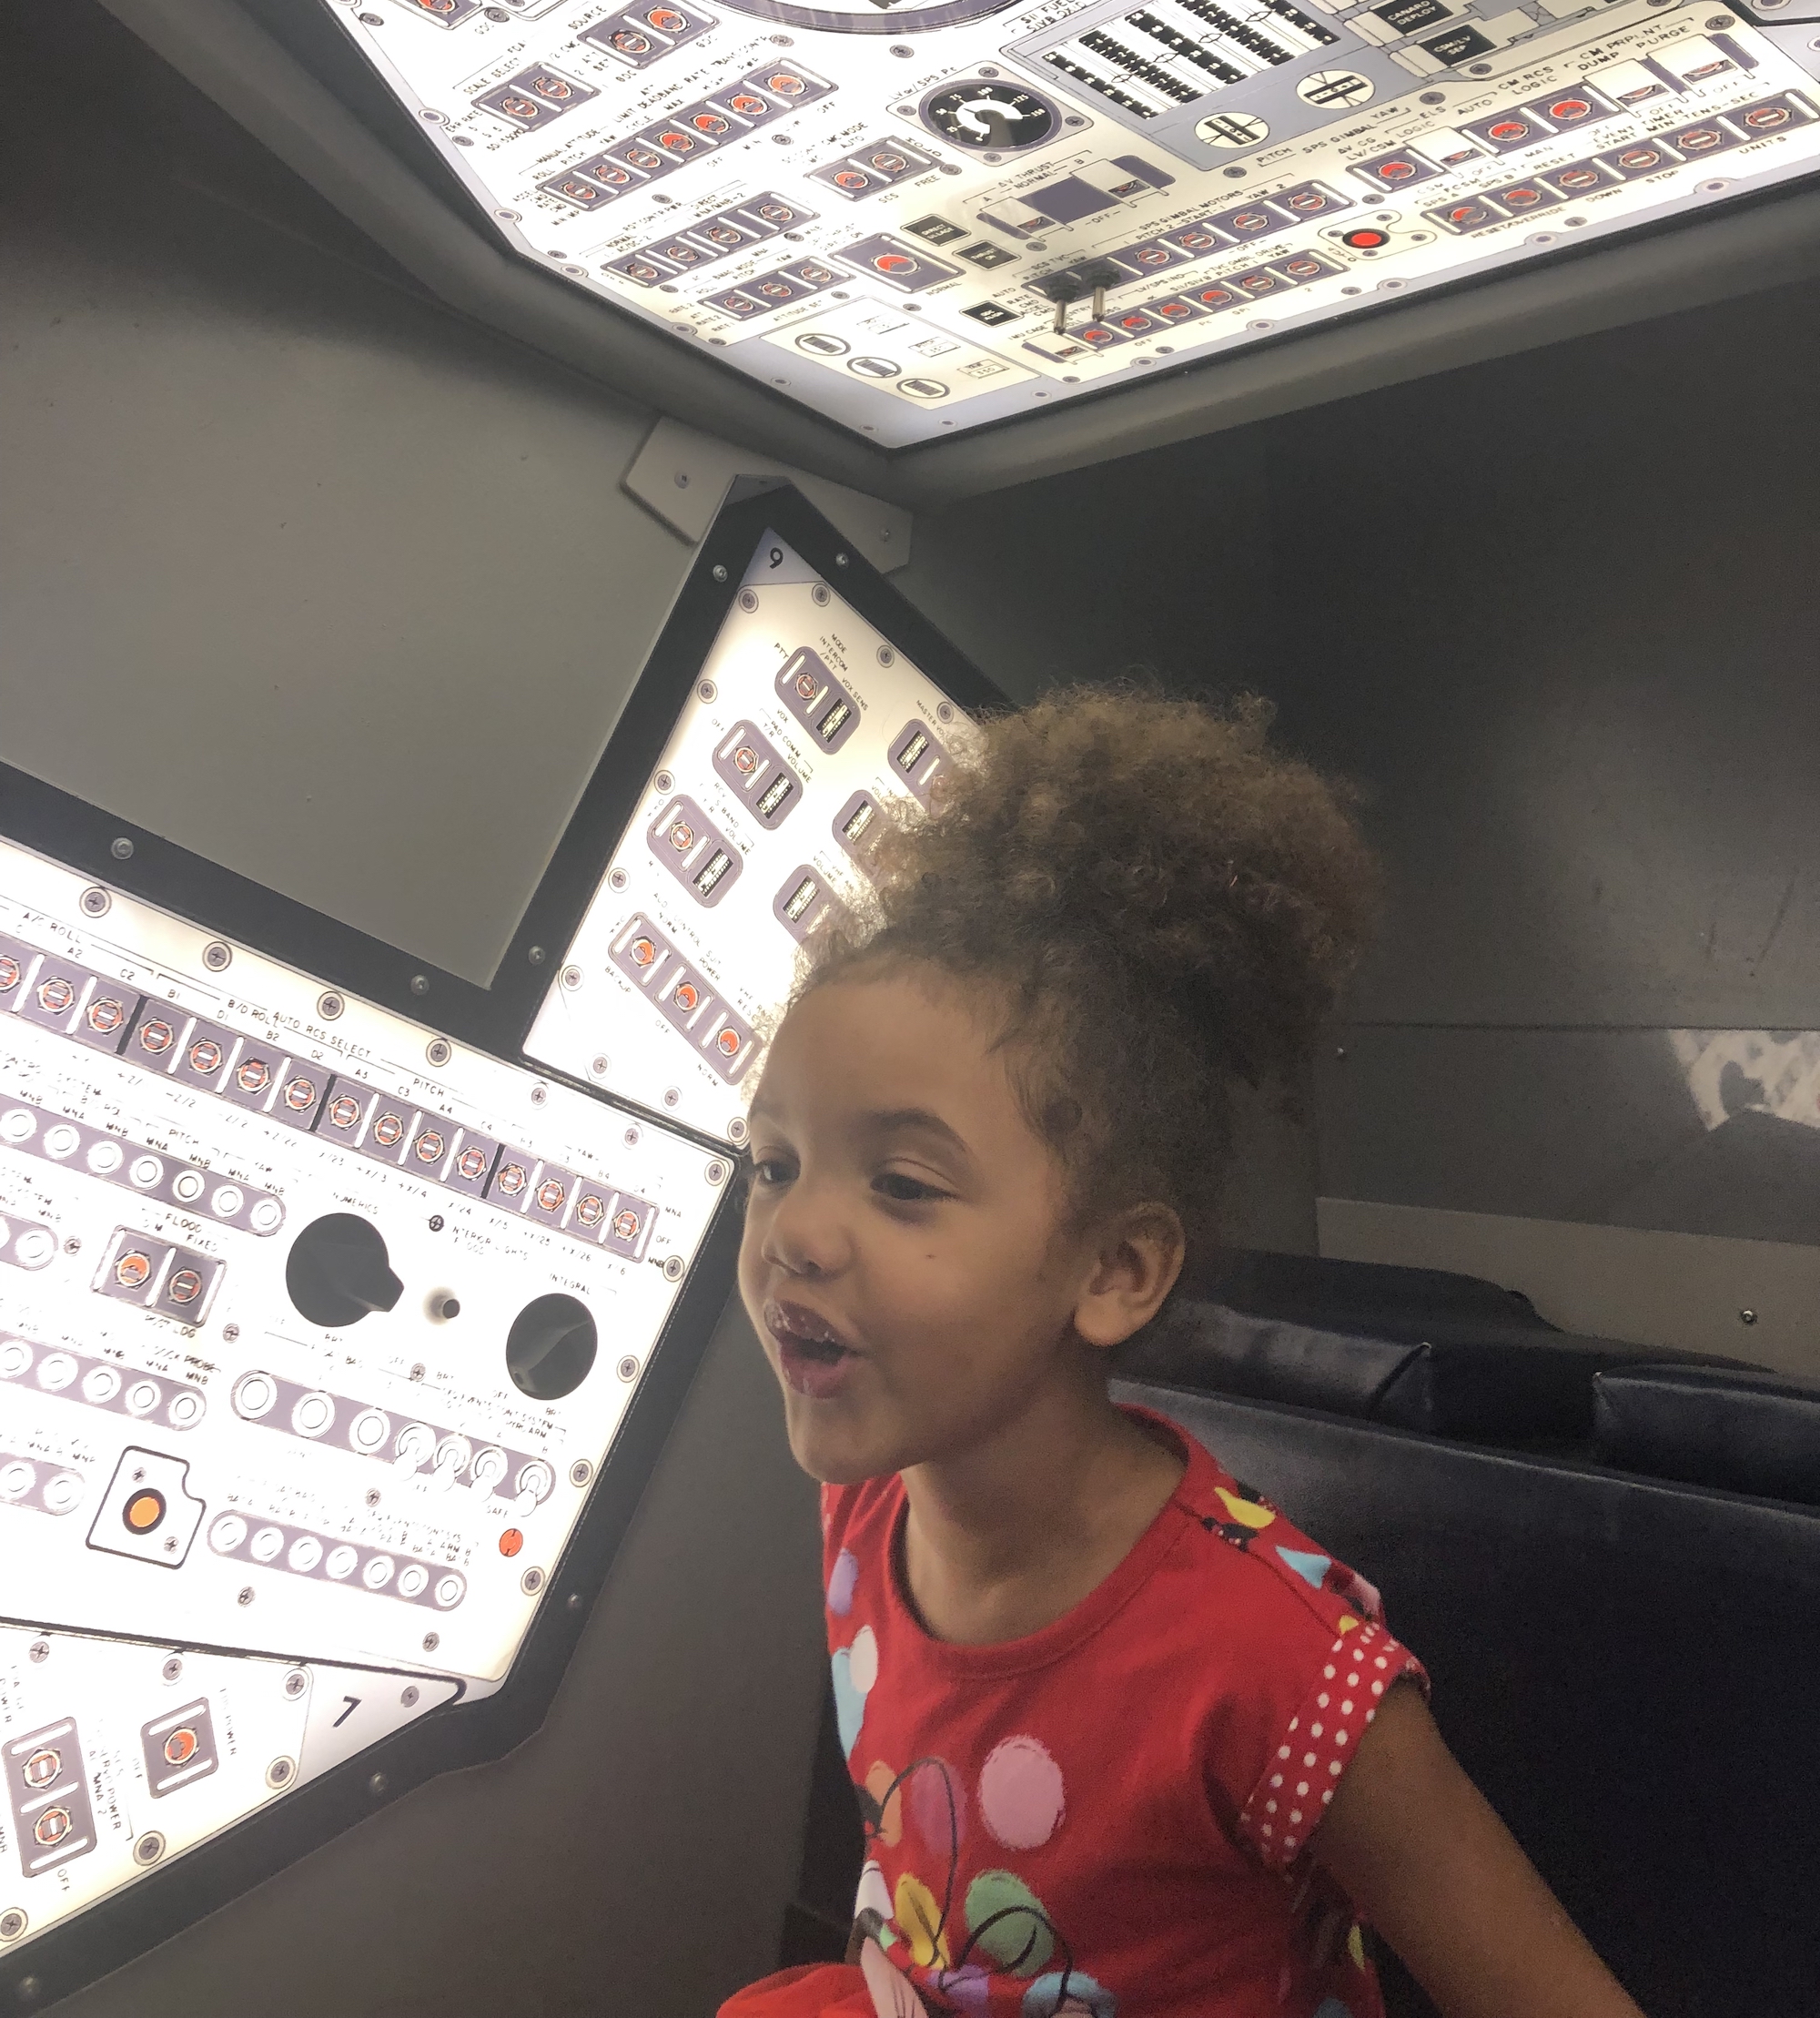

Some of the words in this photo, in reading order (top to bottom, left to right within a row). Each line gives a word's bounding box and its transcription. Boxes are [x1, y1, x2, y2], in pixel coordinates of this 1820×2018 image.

[1577, 51, 1620, 71] DUMP
[1635, 25, 1691, 49] PURGE
[1497, 78, 1520, 90] CM
[1522, 66, 1555, 82] RCS
[1512, 76, 1558, 96] LOGIC
[1395, 121, 1436, 138] LOGIC
[1456, 99, 1493, 116] AUTO
[1420, 106, 1448, 120] ELS
[1640, 107, 1684, 126] TIMER
[1255, 147, 1293, 164] PITCH
[1302, 141, 1328, 154] SPS
[1330, 123, 1379, 144] GIMBAL
[1370, 106, 1400, 120] YAW
[1357, 137, 1377, 147] CG
[1595, 133, 1637, 150] START
[1524, 146, 1554, 158] MAN
[1738, 137, 1788, 155] UNITS
[1533, 153, 1576, 170] RESET
[1015, 161, 1055, 181] THRUST
[1646, 169, 1679, 184] STOP
[877, 191, 900, 205] SCS
[1585, 188, 1623, 203] DOWN
[1138, 220, 1158, 232] SPS
[1158, 208, 1199, 225] GIMBAL
[1198, 189, 1244, 210] MOTORS
[1136, 228, 1165, 241] PITCH
[1237, 241, 1258, 251] OFF
[992, 287, 1016, 299] AUTO
[1006, 294, 1033, 305] RATE
[769, 547, 784, 570] 9
[774, 642, 790, 660] PTT
[831, 634, 848, 654] MODE
[819, 635, 849, 672] INTERCOM
[841, 677, 856, 693] VOX
[852, 692, 869, 711] SENS
[915, 699, 936, 726] MASTER
[786, 753, 813, 785] VOLUME
[49, 922, 81, 945] ROLL
[67, 946, 83, 959] A2
[119, 968, 136, 981] C2
[698, 957, 722, 982] POWER
[167, 989, 181, 999] B1
[227, 999, 248, 1014] B/D
[266, 1030, 280, 1042] B2
[272, 1011, 300, 1029] AUTO
[306, 1025, 328, 1040] RCS
[330, 1036, 372, 1059] SELECT
[310, 1050, 324, 1060] D2
[398, 1086, 410, 1097] C3
[412, 1078, 445, 1098] PITCH
[439, 1104, 453, 1114] A4
[664, 1206, 682, 1218] MNA
[655, 1234, 672, 1245] OFF
[332, 1695, 362, 1729] 7
